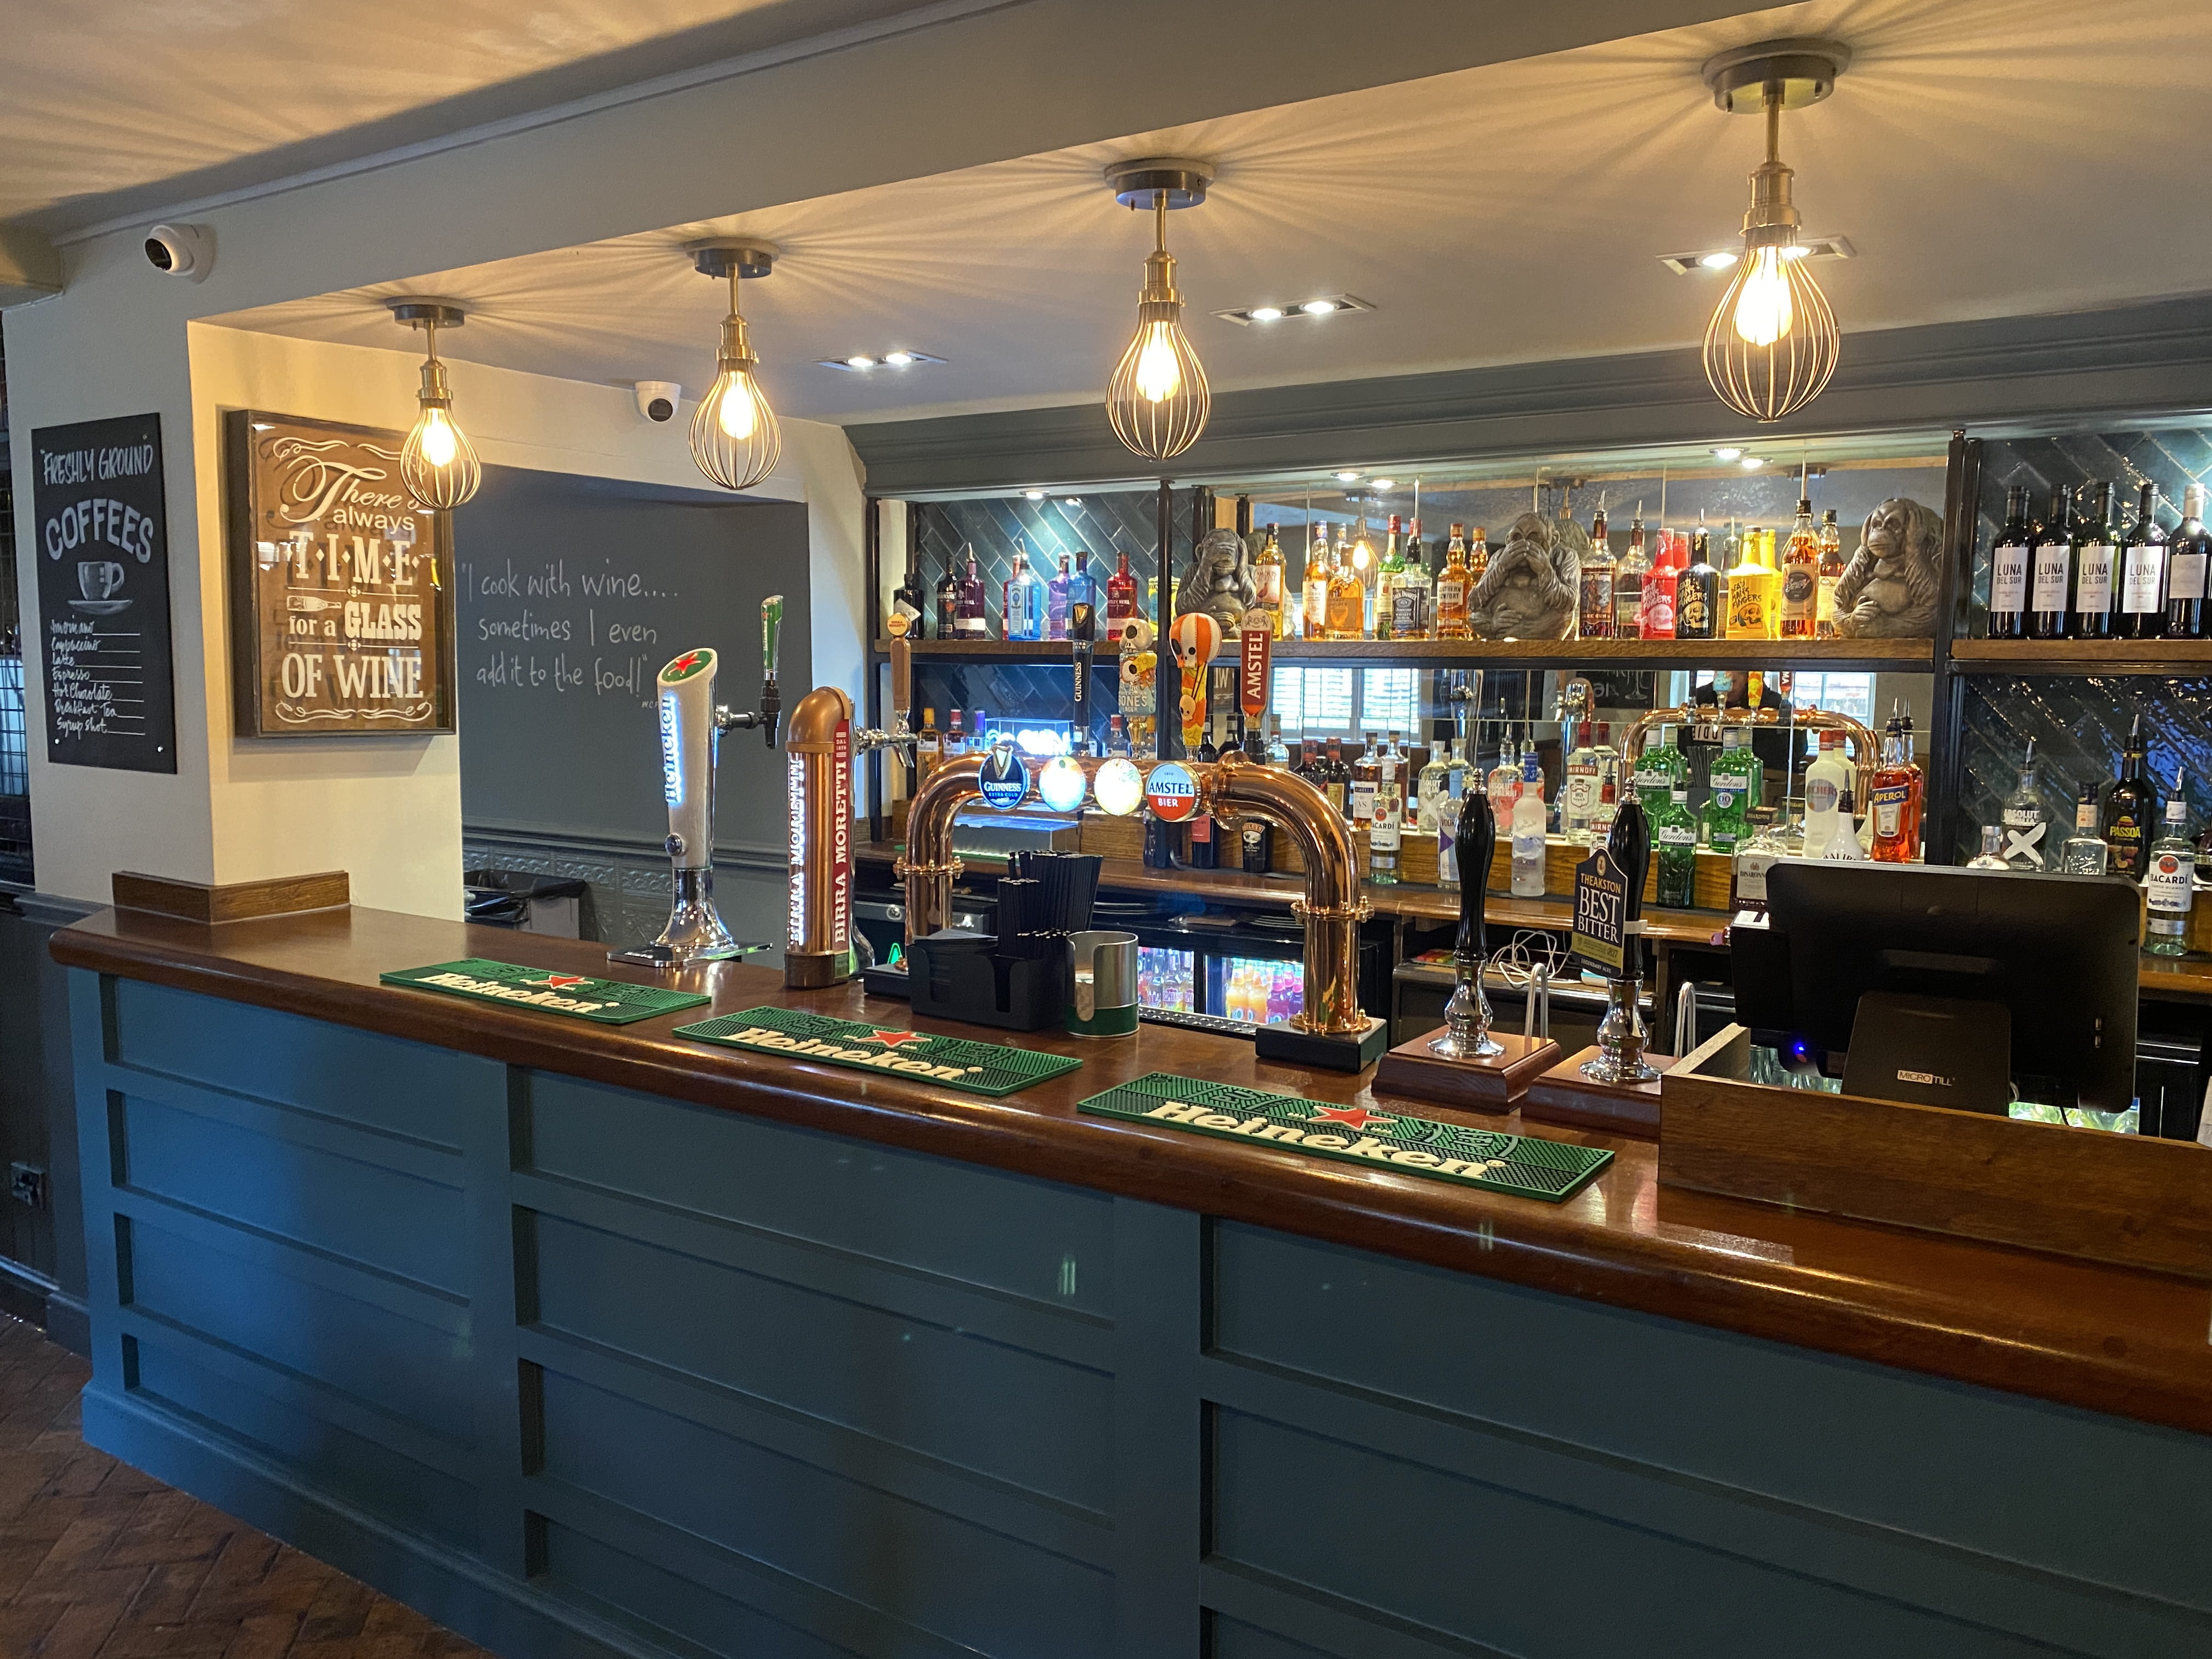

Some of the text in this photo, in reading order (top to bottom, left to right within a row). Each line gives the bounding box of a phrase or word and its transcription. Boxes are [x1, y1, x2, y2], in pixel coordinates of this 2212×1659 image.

[44, 444, 154, 485] FRESHLY GROUND
[279, 454, 421, 523] Theres
[46, 498, 154, 563] COFFEES
[332, 506, 415, 535] always
[481, 558, 521, 597] cook
[527, 558, 571, 598] with
[1997, 563, 2022, 576] LUNA
[2039, 563, 2063, 575] LUNA
[2083, 563, 2108, 575] LUNA
[2130, 564, 2155, 577] LUNA
[2129, 577, 2141, 585] DEL
[288, 600, 422, 641] for a GLASS
[478, 608, 657, 646] sometimes I even
[52, 651, 75, 666] Latte
[1246, 633, 1263, 699] AMSTEL
[51, 665, 90, 685] Espresso
[281, 652, 424, 699] OF WINE
[476, 651, 506, 687] add
[510, 654, 523, 687] it
[529, 656, 546, 686] to
[554, 652, 584, 693] the
[52, 682, 69, 698] Hot
[54, 698, 118, 717] Breakfast Tea
[57, 716, 83, 740] Syrup
[662, 696, 681, 803] Heineken
[1568, 766, 1597, 775] MIRNOFF
[984, 781, 1022, 792] GUINNESS
[1149, 782, 1193, 795] AMSTEL
[1874, 789, 1906, 804] APEROL
[1158, 798, 1178, 807] BIER
[2004, 808, 2040, 820] ABSOLUT
[1372, 822, 1395, 830] ACARDÍ
[1660, 829, 1692, 842] Gordon's
[834, 761, 847, 943] BIRRA MORETTI
[1580, 872, 1622, 894] THEAKSTON
[2150, 873, 2188, 884] BACARDÍ
[1578, 885, 1620, 926] BEST
[1577, 915, 1619, 944] BITTER
[1581, 958, 1602, 970] LEGENDARY
[414, 972, 603, 1014] Heineken
[719, 1027, 966, 1080] Heineken
[1141, 1100, 1489, 1180] Heineken
